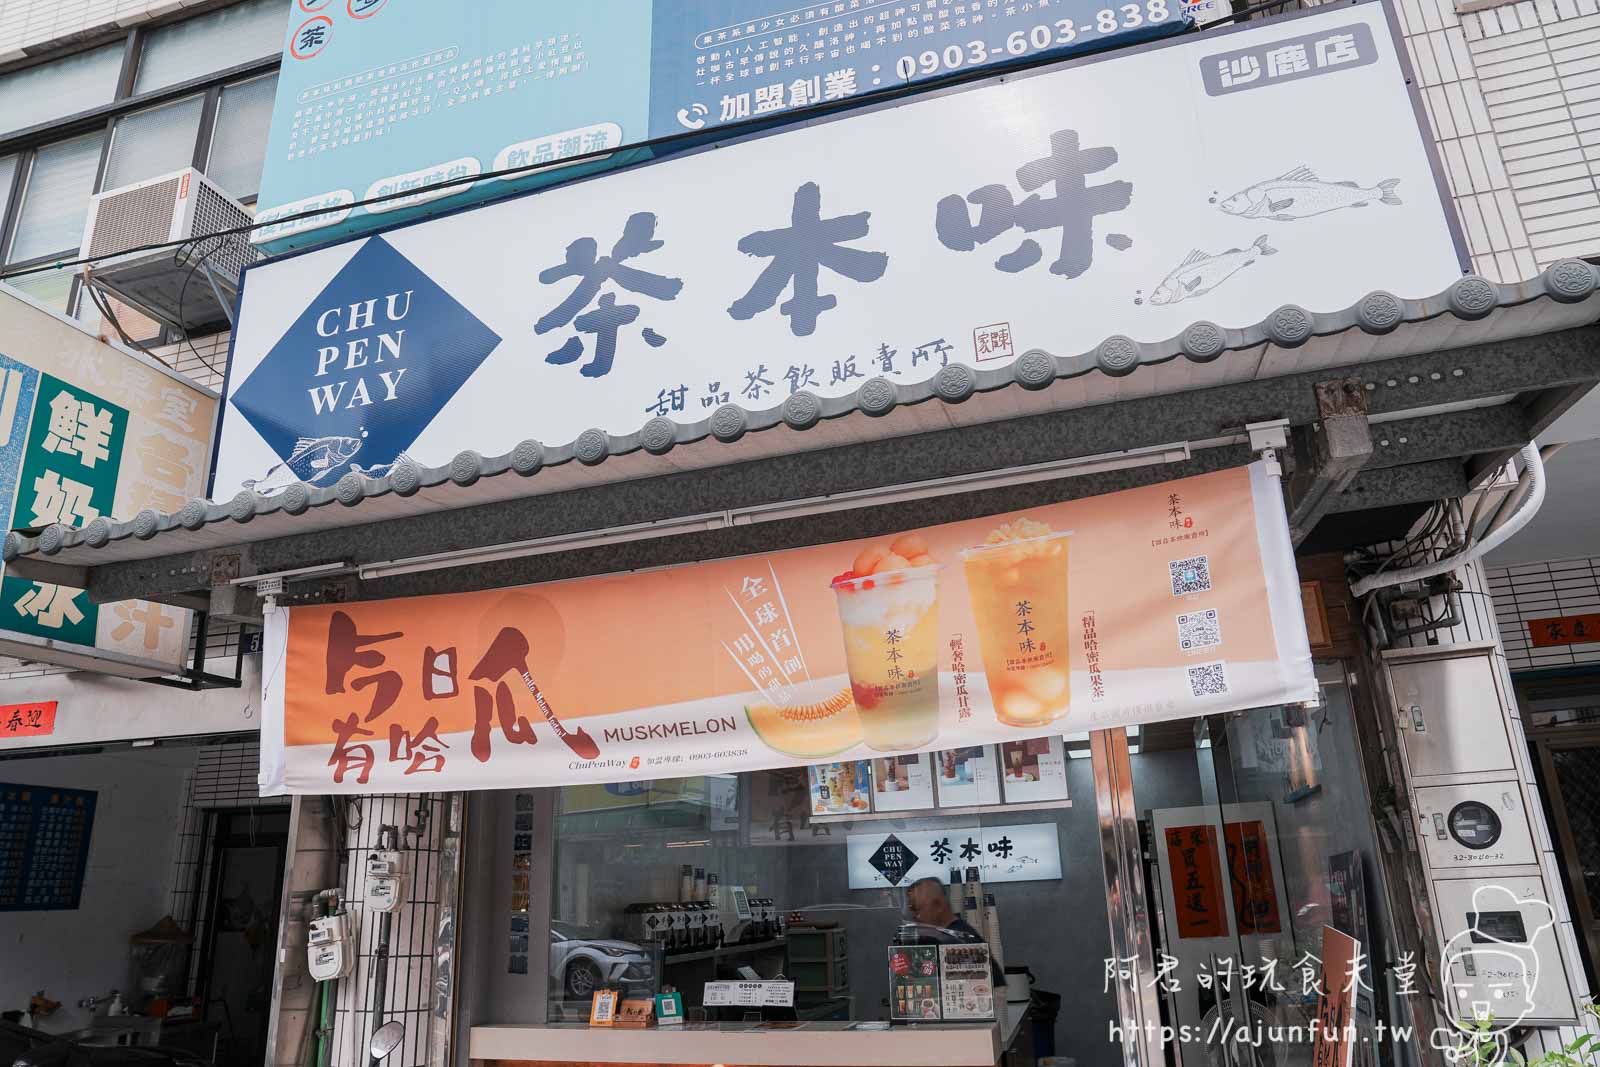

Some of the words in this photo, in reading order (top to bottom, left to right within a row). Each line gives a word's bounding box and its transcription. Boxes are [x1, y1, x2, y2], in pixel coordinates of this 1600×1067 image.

[299, 26, 325, 50] 茶
[896, 0, 1169, 79] 0903-603-838
[1218, 34, 1360, 88] 沙鹿店
[507, 130, 609, 169] 飲品潮流
[534, 129, 1134, 378] 茶本味
[316, 290, 414, 338] CHU
[314, 330, 406, 377] PEN
[645, 338, 954, 417] 甜品茶飲販賣所
[307, 368, 408, 416] WAY
[1167, 493, 1183, 529] 茶本味
[741, 576, 803, 675] 全球首創
[1015, 600, 1036, 653] 茶本味
[886, 629, 904, 680] 茶本味
[604, 716, 737, 743] MUSKMELON
[568, 758, 628, 771] ChuPenWay
[883, 846, 903, 854] CHU
[930, 836, 1013, 865] 茶本味
